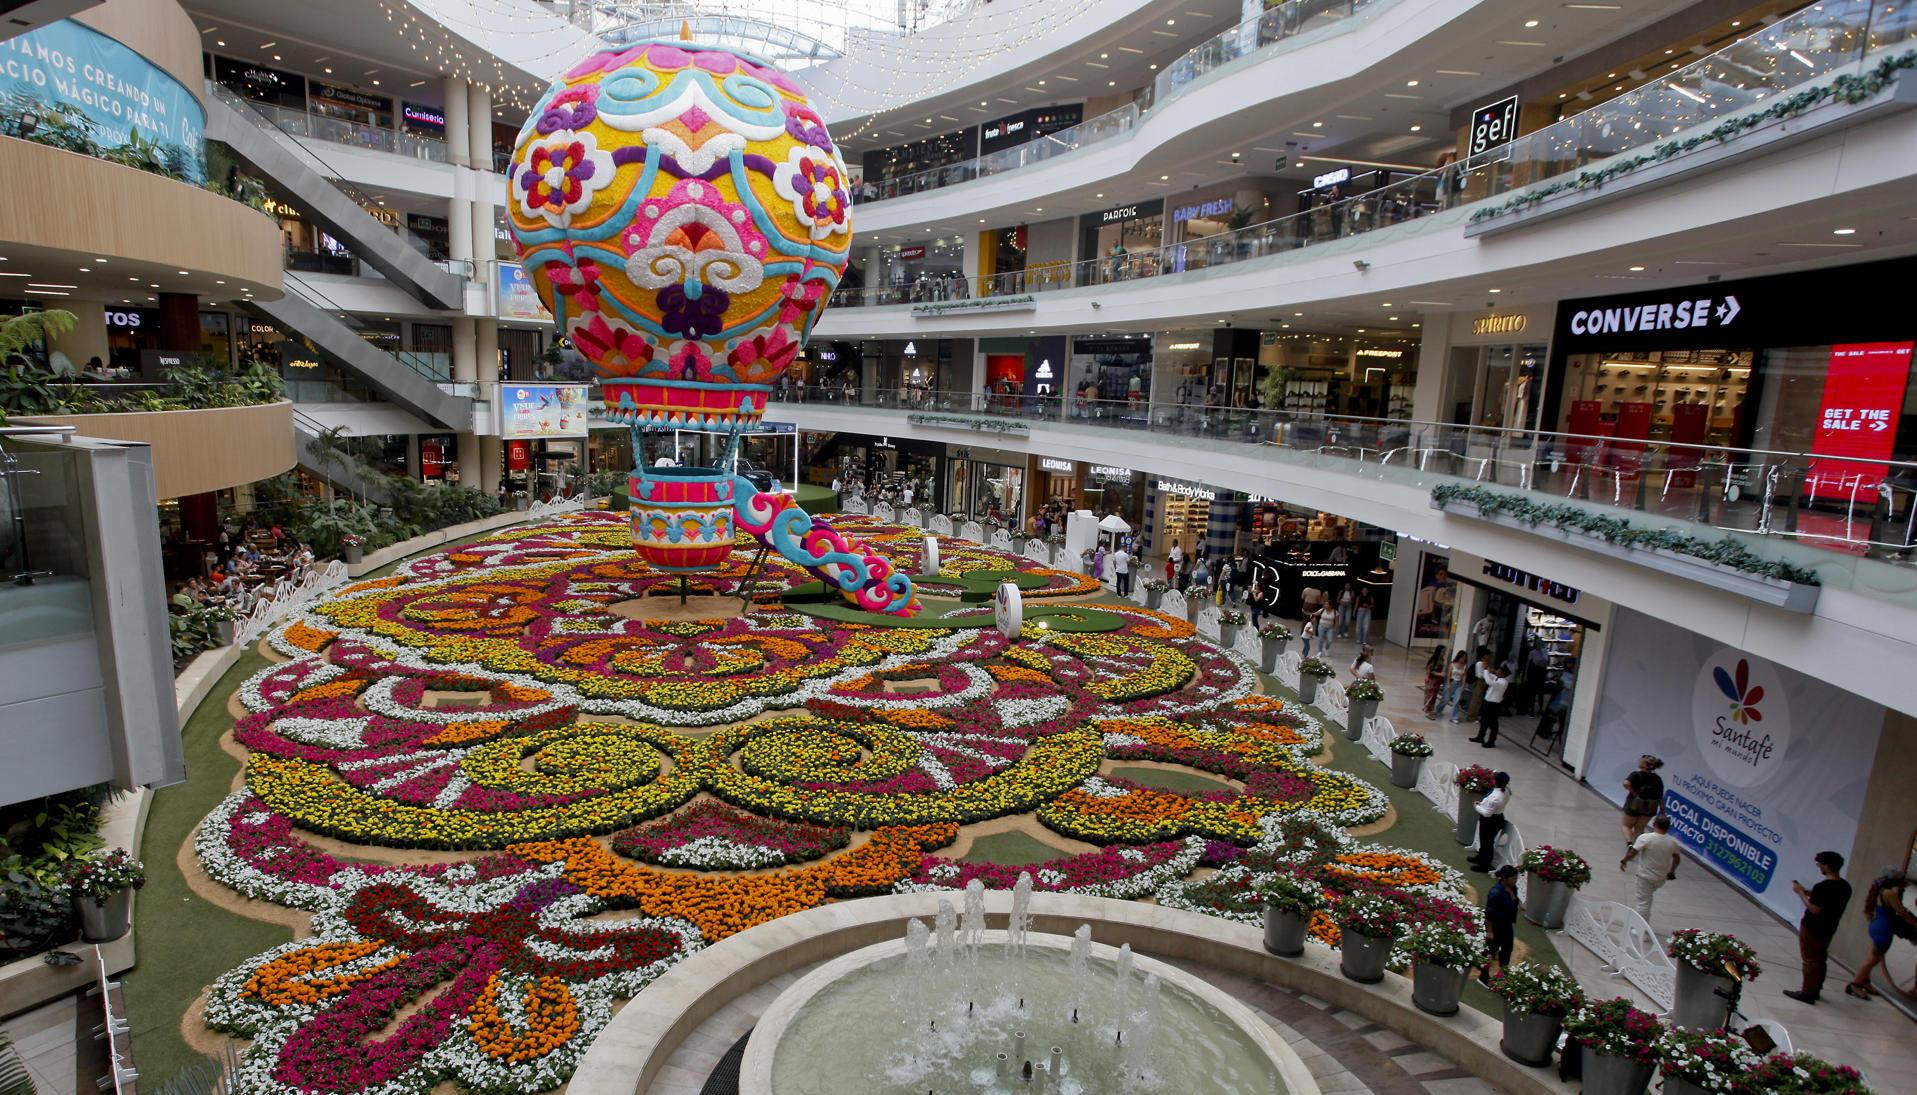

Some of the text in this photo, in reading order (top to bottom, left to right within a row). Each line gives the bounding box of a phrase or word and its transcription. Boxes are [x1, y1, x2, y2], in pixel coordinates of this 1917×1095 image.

[84, 63, 149, 107] CREANDO
[153, 96, 167, 116] UN
[55, 78, 122, 117] MÁGICO
[126, 106, 158, 134] PARA
[160, 120, 170, 140] TI
[1474, 104, 1512, 153] gef
[1200, 198, 1232, 217] FRESH
[1570, 299, 1712, 335] CONVERSE
[1822, 419, 1862, 430] SALE
[1824, 408, 1891, 420] GET THE
[1042, 458, 1072, 472] LEONISA
[1090, 465, 1131, 476] LEONISA
[1158, 480, 1172, 492] Bath
[1177, 484, 1195, 498] Body
[1194, 488, 1215, 501] Works
[1711, 739, 1753, 764] mi mundo
[1712, 715, 1774, 767] Santafé
[1672, 774, 1681, 787] TU
[1716, 800, 1738, 819] GRAN
[1711, 783, 1736, 804] PUEDE
[1735, 797, 1762, 819] NACER
[1665, 796, 1772, 871] LOCAL DISPONIBLE
[1665, 813, 1766, 885] ONTACTO 3127962103
